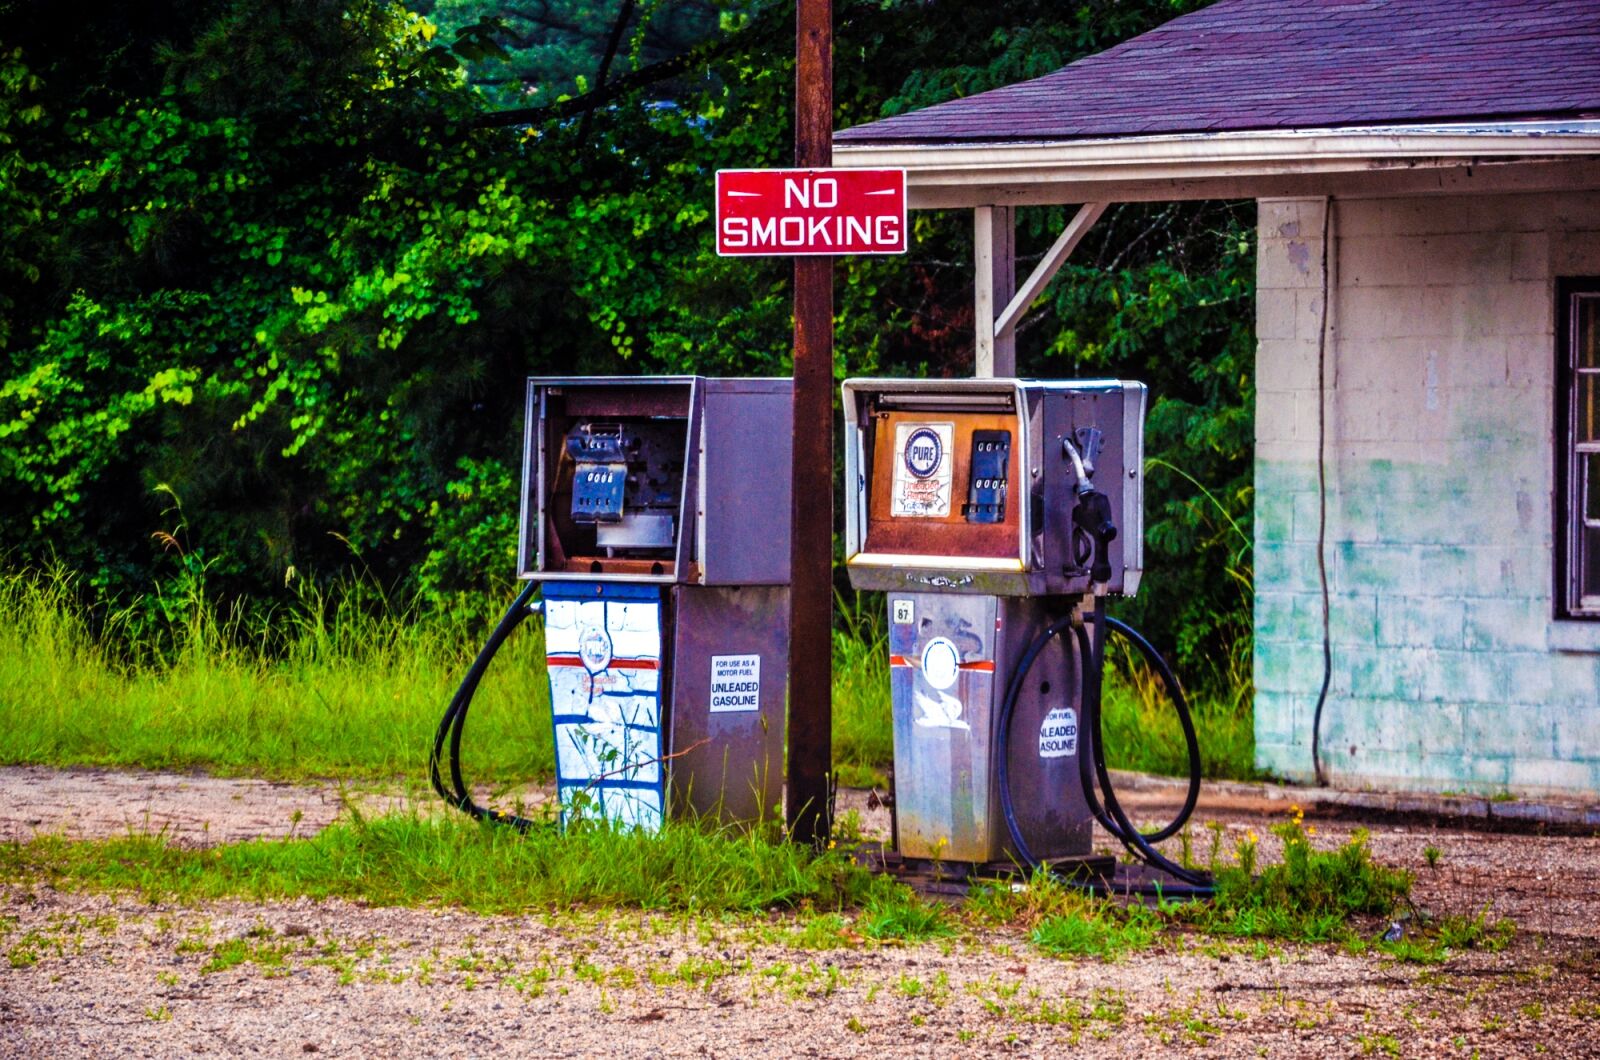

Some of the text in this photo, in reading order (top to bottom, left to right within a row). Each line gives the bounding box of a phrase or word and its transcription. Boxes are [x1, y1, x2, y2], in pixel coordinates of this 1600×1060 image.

[784, 178, 838, 209] NO
[723, 215, 899, 247] SMOKING
[912, 446, 934, 461] PURE
[898, 609, 908, 620] 87
[712, 682, 758, 692] UNLEADED
[713, 695, 756, 706] GASOLINE
